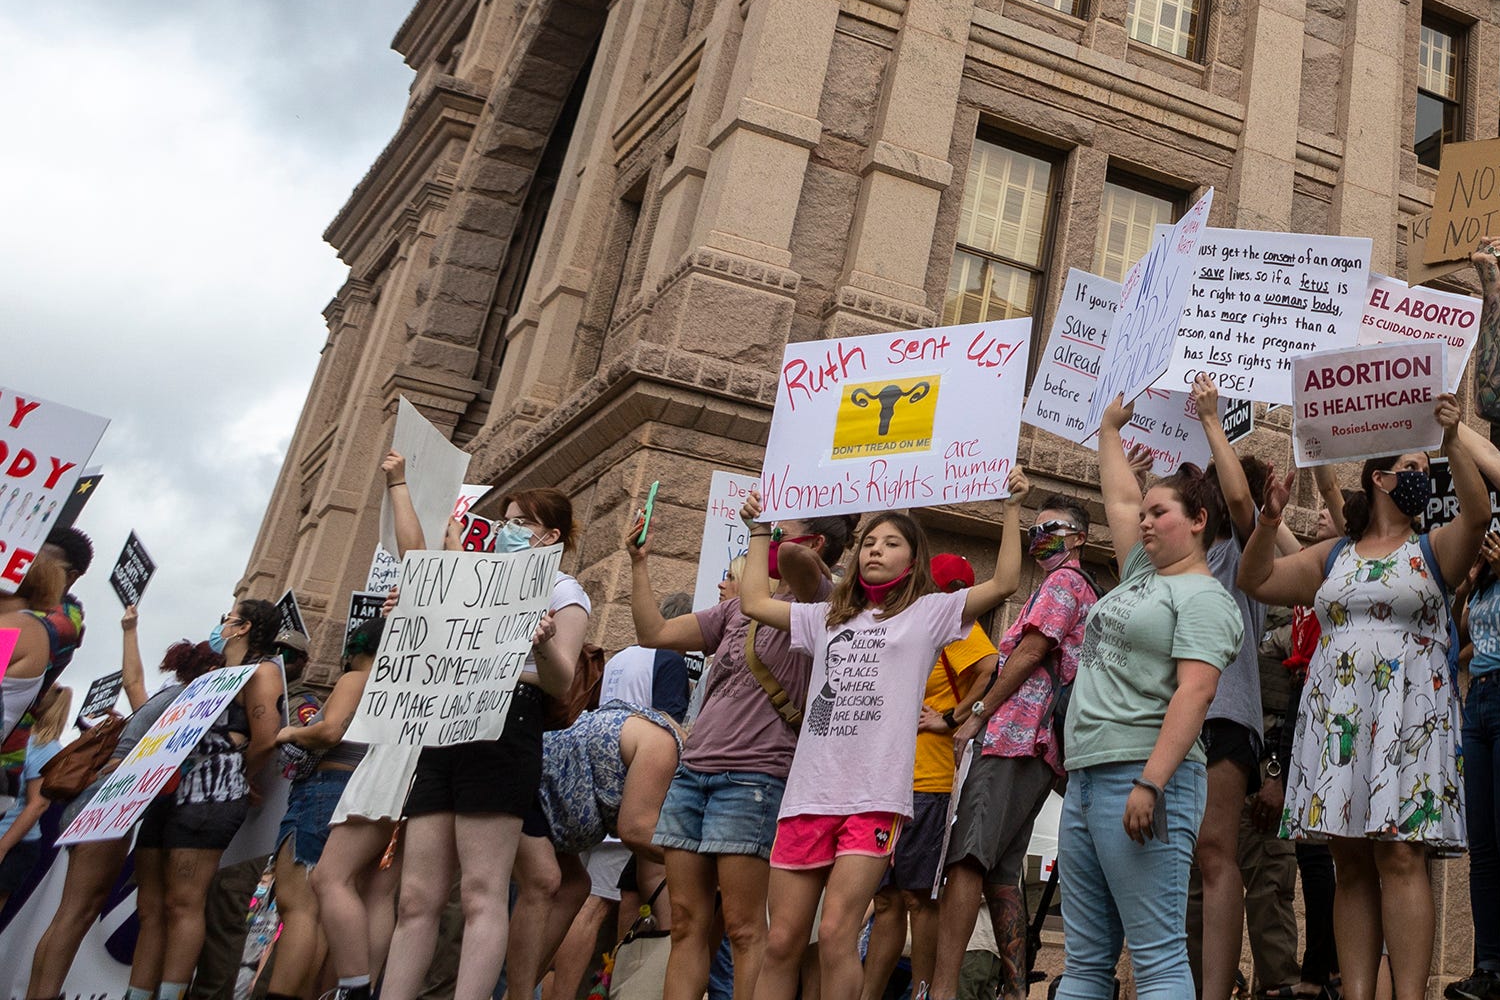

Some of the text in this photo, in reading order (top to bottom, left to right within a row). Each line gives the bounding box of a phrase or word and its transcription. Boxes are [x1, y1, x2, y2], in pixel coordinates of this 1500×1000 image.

[1443, 210, 1498, 254] NOT
[1221, 246, 1239, 261] get
[1242, 245, 1260, 260] the
[1263, 251, 1296, 263] consent
[1298, 247, 1313, 264] of
[1313, 255, 1328, 266] an
[1330, 256, 1362, 273] organ
[1076, 283, 1087, 301] If
[1200, 266, 1225, 278] save
[1271, 269, 1283, 283] if
[1284, 276, 1291, 285] a
[1300, 273, 1329, 291] fetus
[1338, 282, 1348, 295] is
[1210, 287, 1343, 317] right to a womans body,
[1369, 288, 1476, 329] EL ABORTO
[1197, 304, 1337, 335] has more rights than a
[1361, 314, 1374, 325] ES
[1376, 318, 1421, 339] CUIDADO
[1178, 328, 1317, 353] erson, and the pregnant
[1183, 345, 1272, 370] has less rights
[783, 335, 951, 412] Ruth sent
[1304, 355, 1432, 392] ABORTION
[1044, 373, 1080, 403] before
[1036, 400, 1085, 431] born into
[1304, 387, 1432, 418] IS HEALTHCARE
[1130, 411, 1189, 441] more to be
[1332, 418, 1413, 437] RosiesLaw.org
[832, 438, 931, 456] DON'T TREAD ON ME
[944, 438, 982, 459] are
[944, 456, 1010, 481] human
[762, 459, 934, 513] Women's Rights
[942, 475, 1010, 503] rights!
[711, 498, 736, 520] the
[399, 557, 459, 607] MEN
[463, 558, 516, 609] STILL
[360, 605, 376, 617] AM
[383, 616, 428, 653] FIND
[445, 617, 490, 651] THE
[851, 639, 885, 649] BELONG
[374, 652, 526, 686] BUT SOMEHOW GET
[843, 667, 878, 677] PLACES
[847, 653, 880, 663] IN ALL
[840, 681, 876, 691] WHERE
[366, 689, 514, 720] TO MAKE LAWS ABOUT
[836, 696, 884, 707] DECISIONS
[833, 711, 881, 721] ARE BEING
[398, 715, 482, 746] MY UTERUS
[830, 726, 858, 736] MADE
[128, 763, 176, 797] NOT
